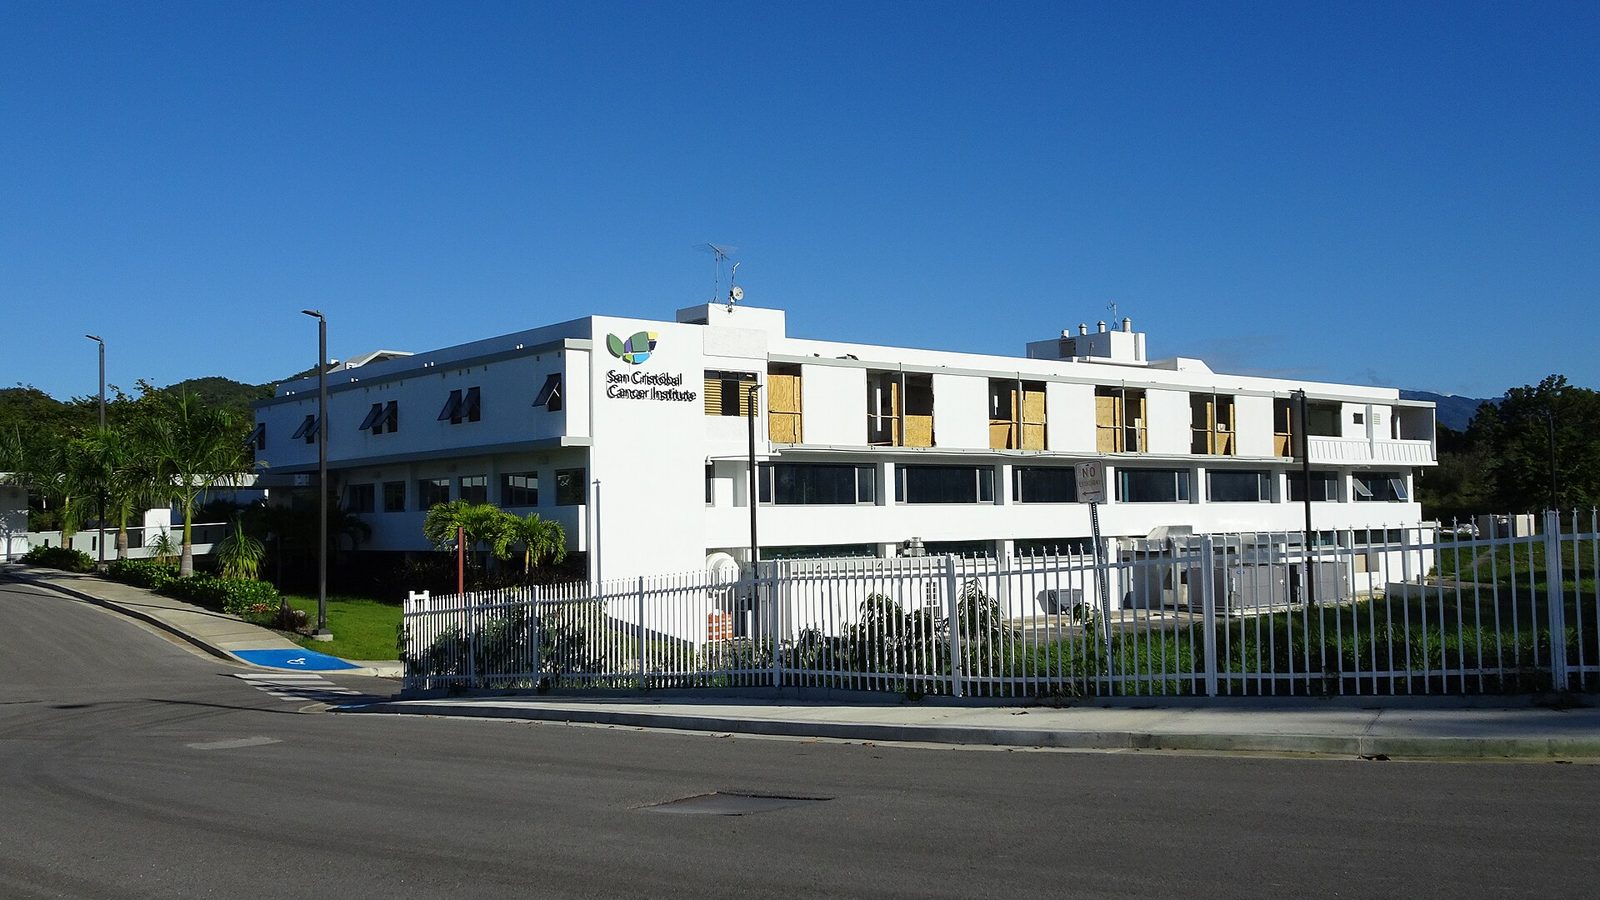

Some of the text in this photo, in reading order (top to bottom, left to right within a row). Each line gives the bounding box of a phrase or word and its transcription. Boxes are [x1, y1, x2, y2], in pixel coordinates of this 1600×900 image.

[606, 369, 682, 386] San Cristóbal
[606, 384, 697, 402] Cancer Institute
[1082, 467, 1096, 478] NO
